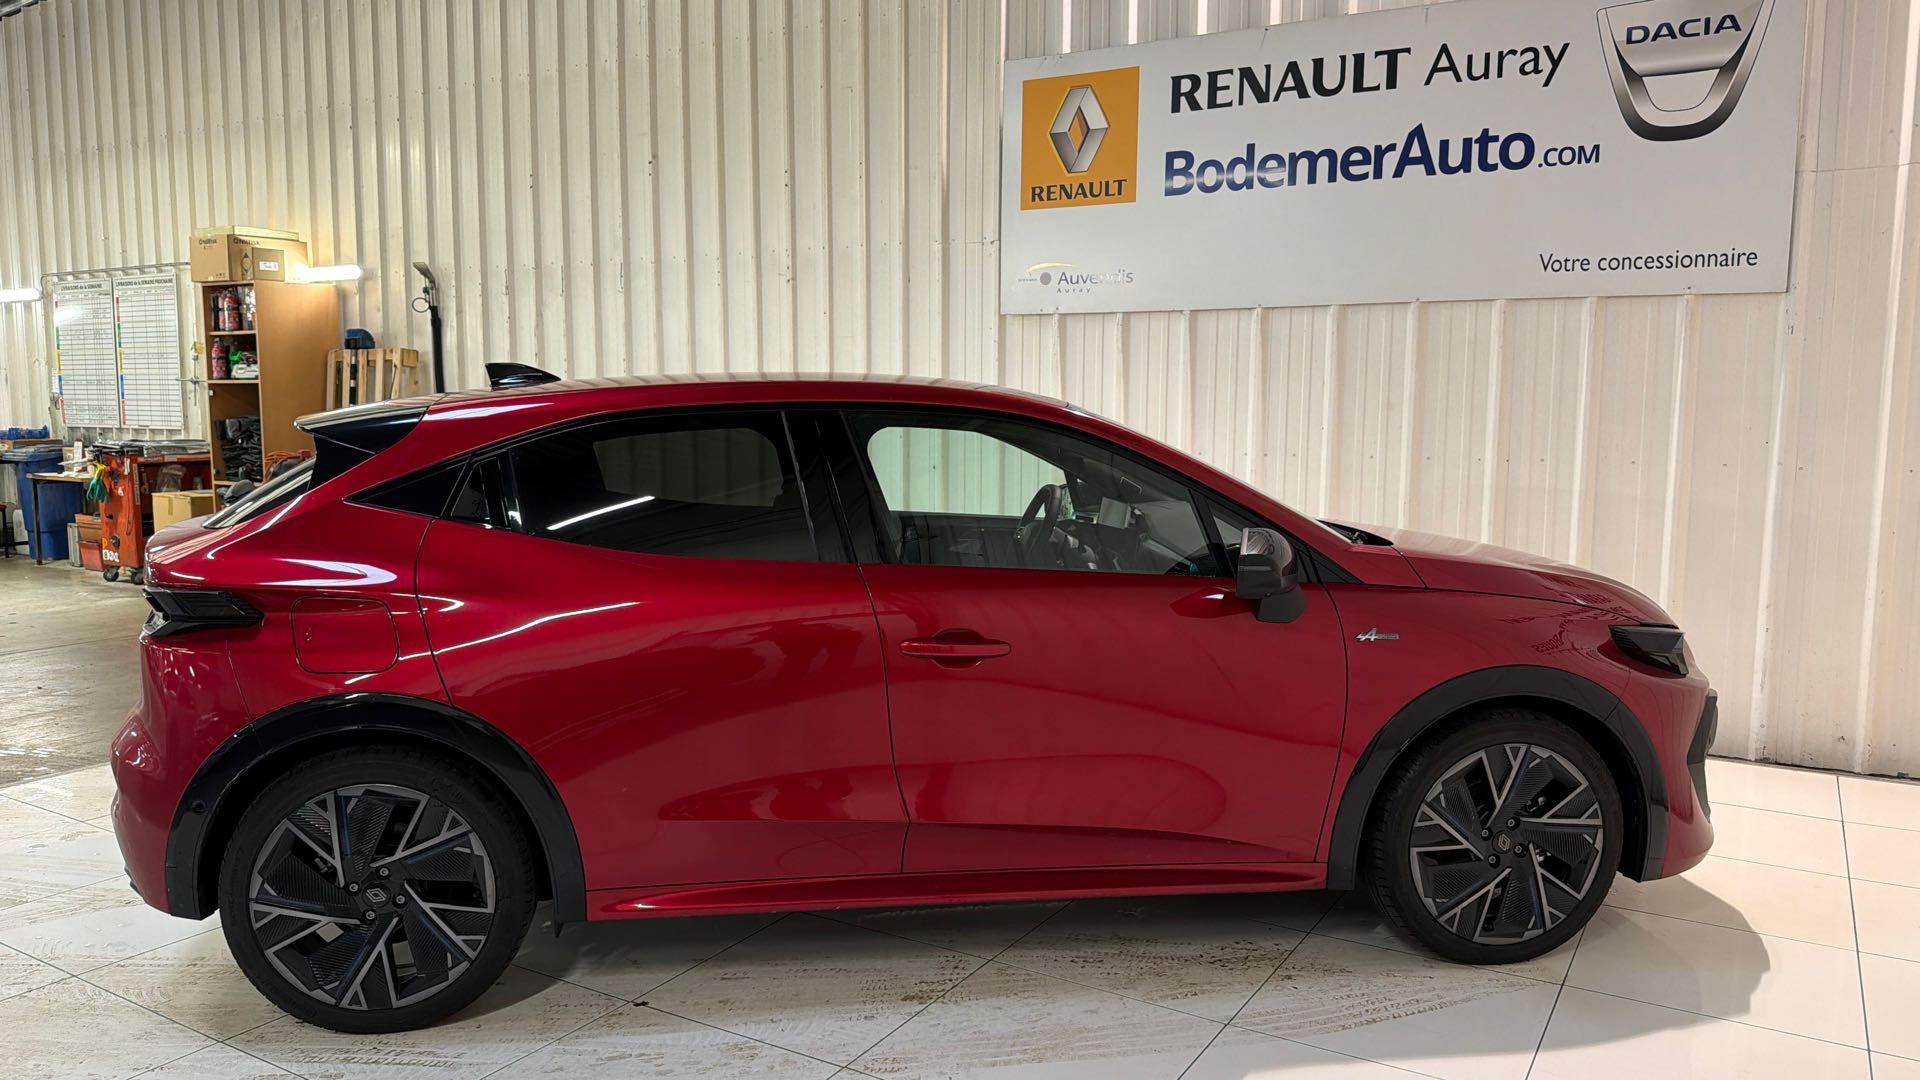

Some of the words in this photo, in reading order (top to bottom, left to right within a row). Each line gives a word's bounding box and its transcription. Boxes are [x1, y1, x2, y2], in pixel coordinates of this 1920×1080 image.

[1626, 14, 1742, 45] DACIA
[1171, 47, 1411, 113] RENAULT
[1424, 43, 1570, 87] Auray
[1031, 179, 1127, 202] RENAULT
[1539, 253, 1591, 272] Votre
[1597, 248, 1758, 271] concessionnaire
